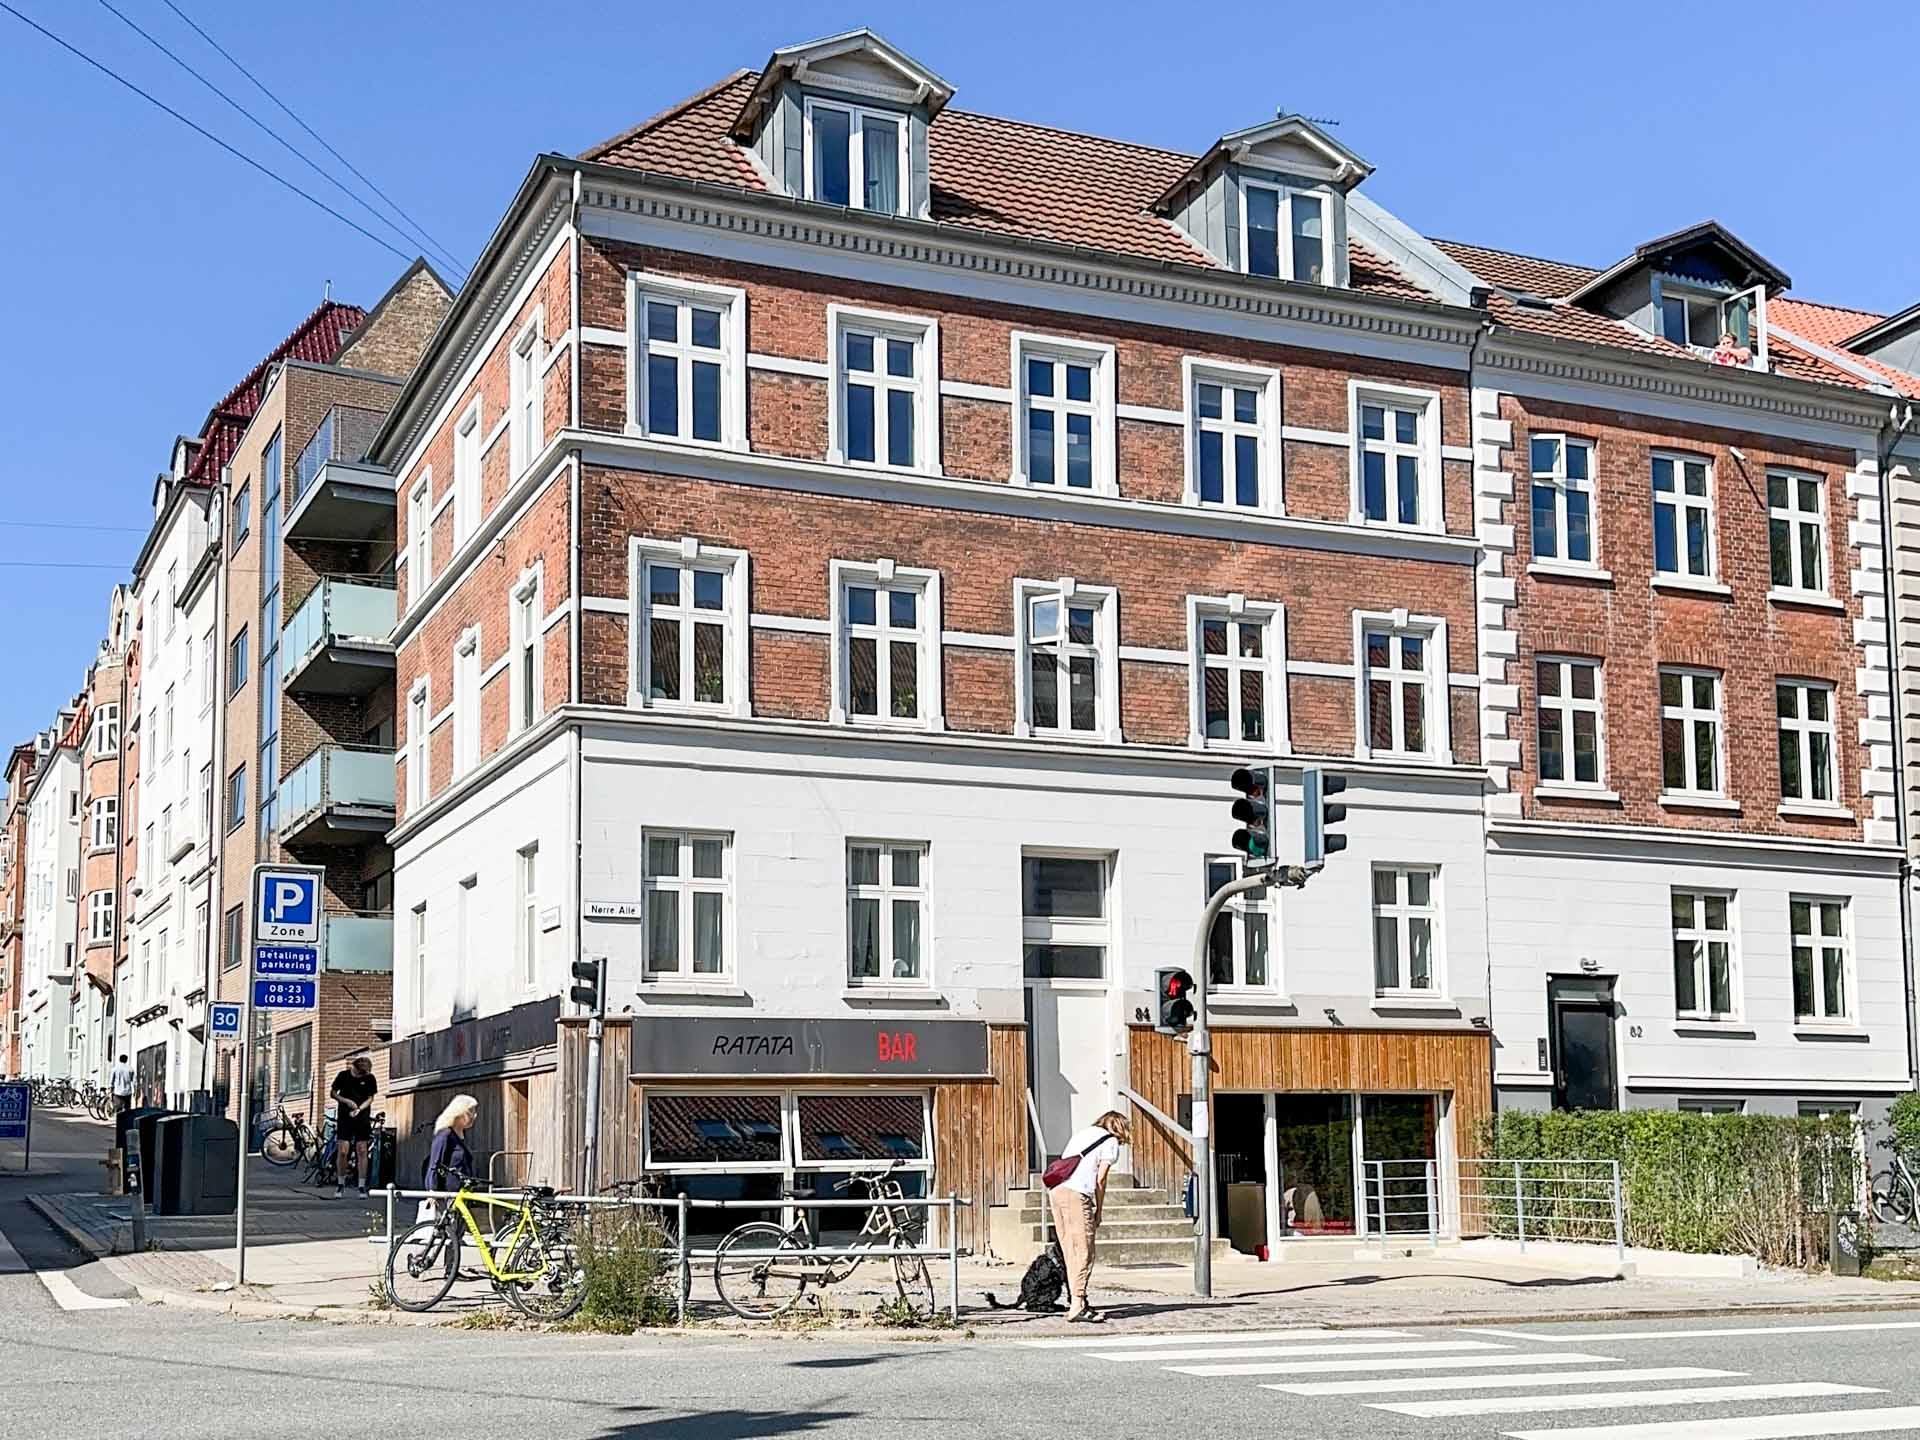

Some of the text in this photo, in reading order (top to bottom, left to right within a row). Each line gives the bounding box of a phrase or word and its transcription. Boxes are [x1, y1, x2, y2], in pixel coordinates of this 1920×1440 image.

[275, 882, 305, 919] P
[270, 925, 305, 937] Zone
[261, 961, 312, 971] parkering
[269, 984, 302, 993] 08-23
[264, 994, 306, 1004] (08-23)
[215, 1012, 237, 1026] 30
[1135, 1007, 1151, 1022] 84
[711, 1032, 917, 1062] RATATA BAR
